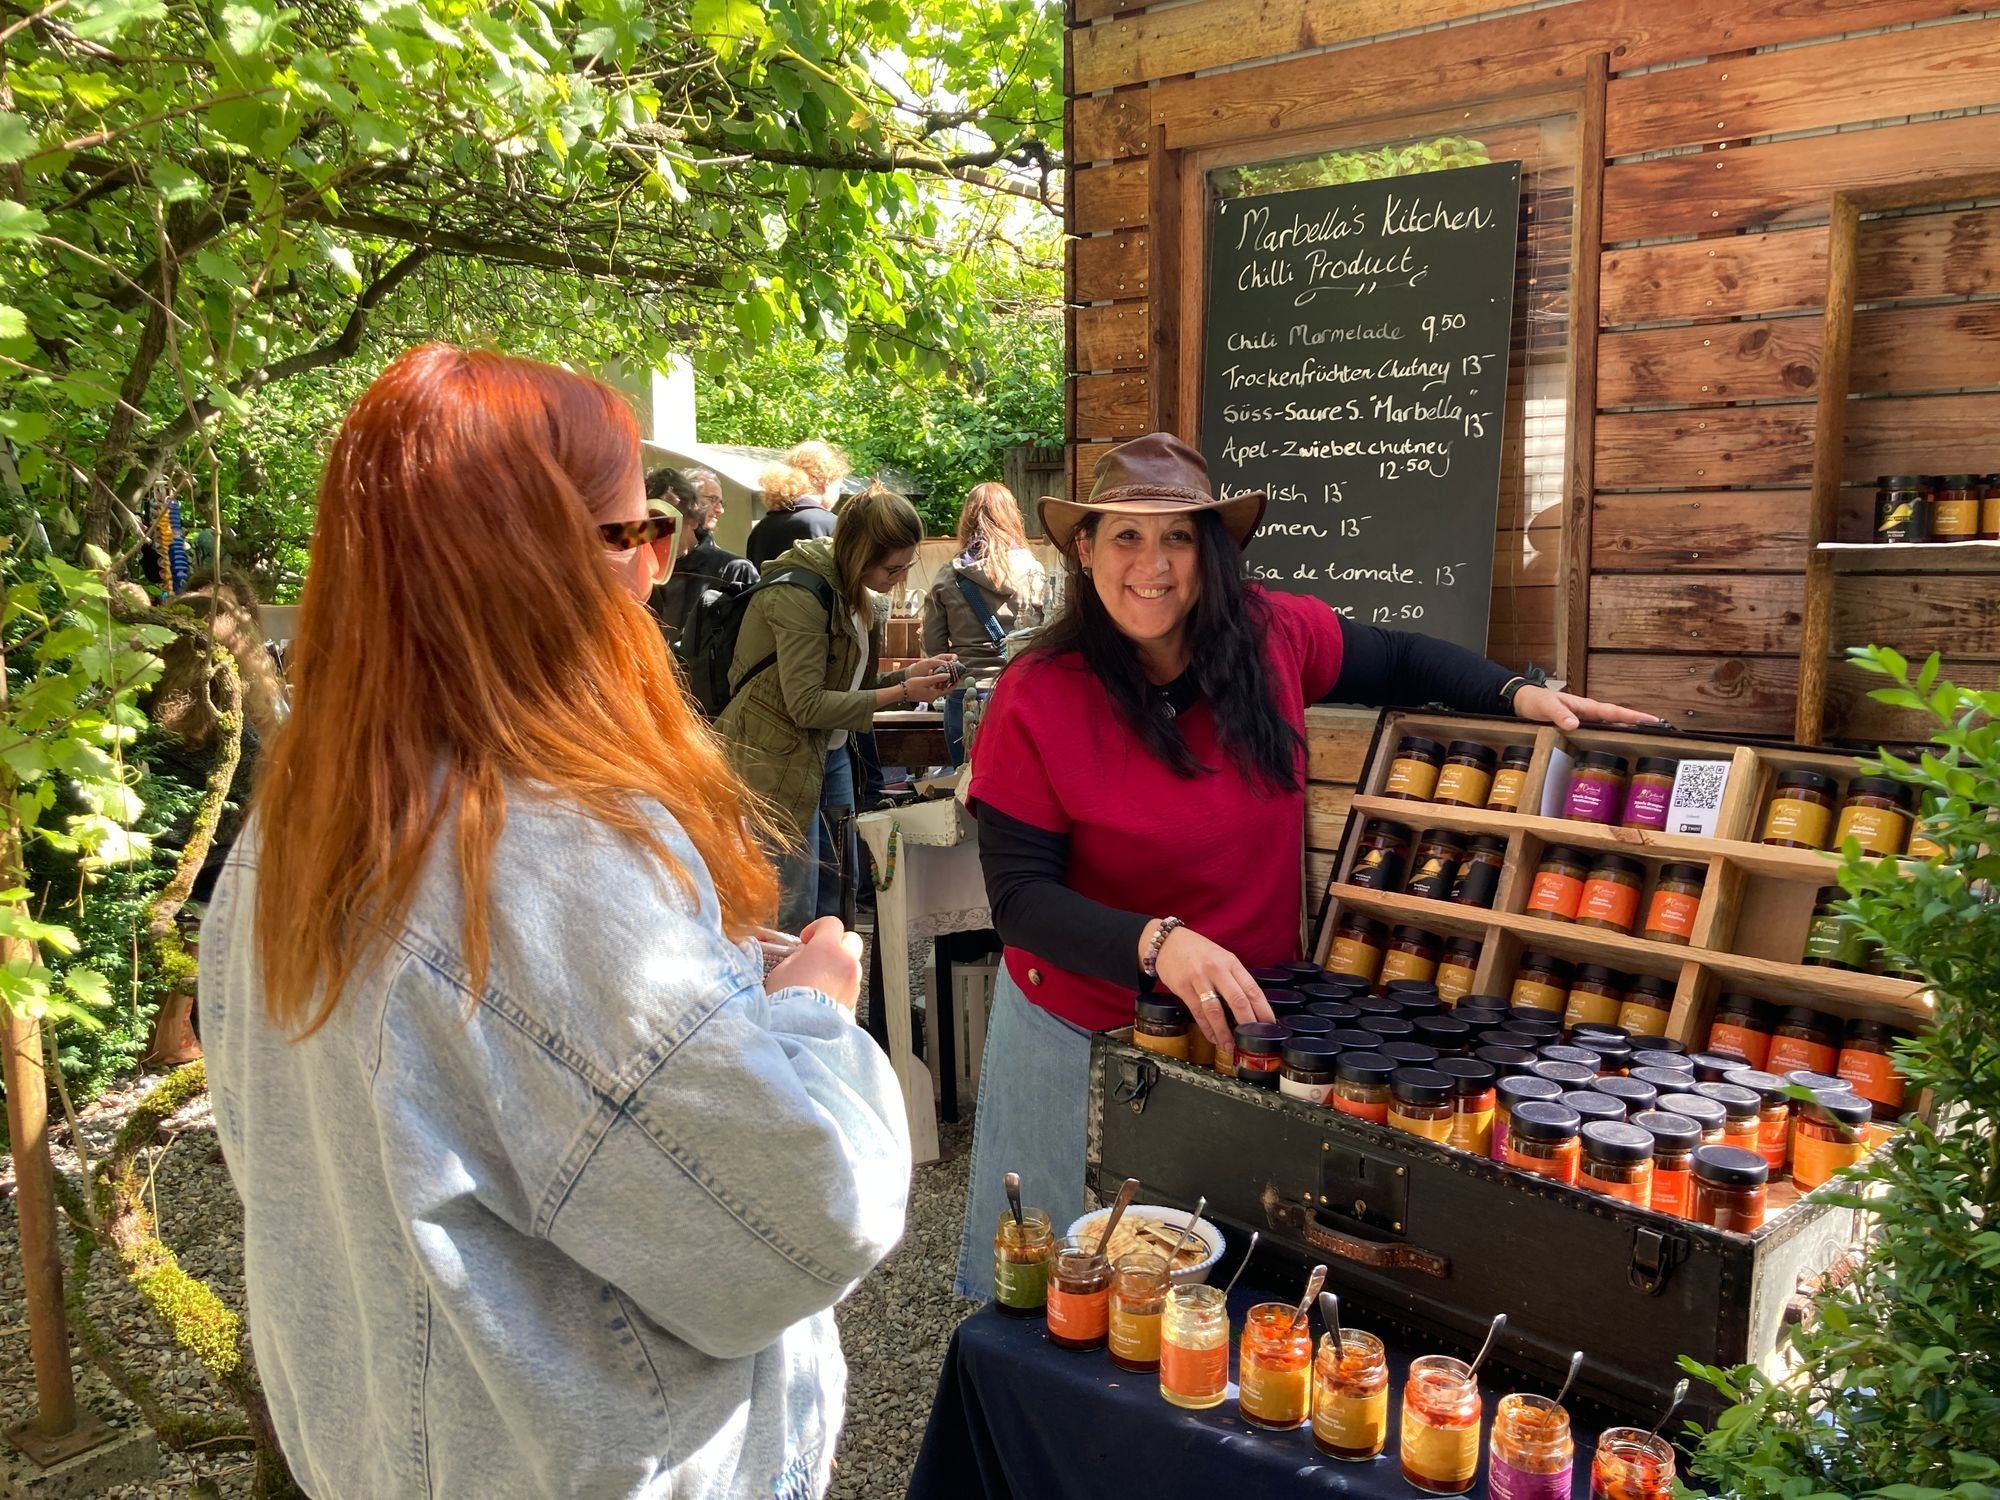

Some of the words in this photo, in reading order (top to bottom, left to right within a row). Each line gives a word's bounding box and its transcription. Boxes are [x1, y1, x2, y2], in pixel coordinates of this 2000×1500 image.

[1234, 205, 1365, 252] Marbella's
[1237, 259, 1293, 292] Chilli
[1227, 332, 1278, 352] Chili
[1289, 320, 1406, 347] Marmelade
[1221, 357, 1374, 391] Trockenfrüchten
[1378, 357, 1451, 392] Chutney
[1292, 562, 1319, 581] de
